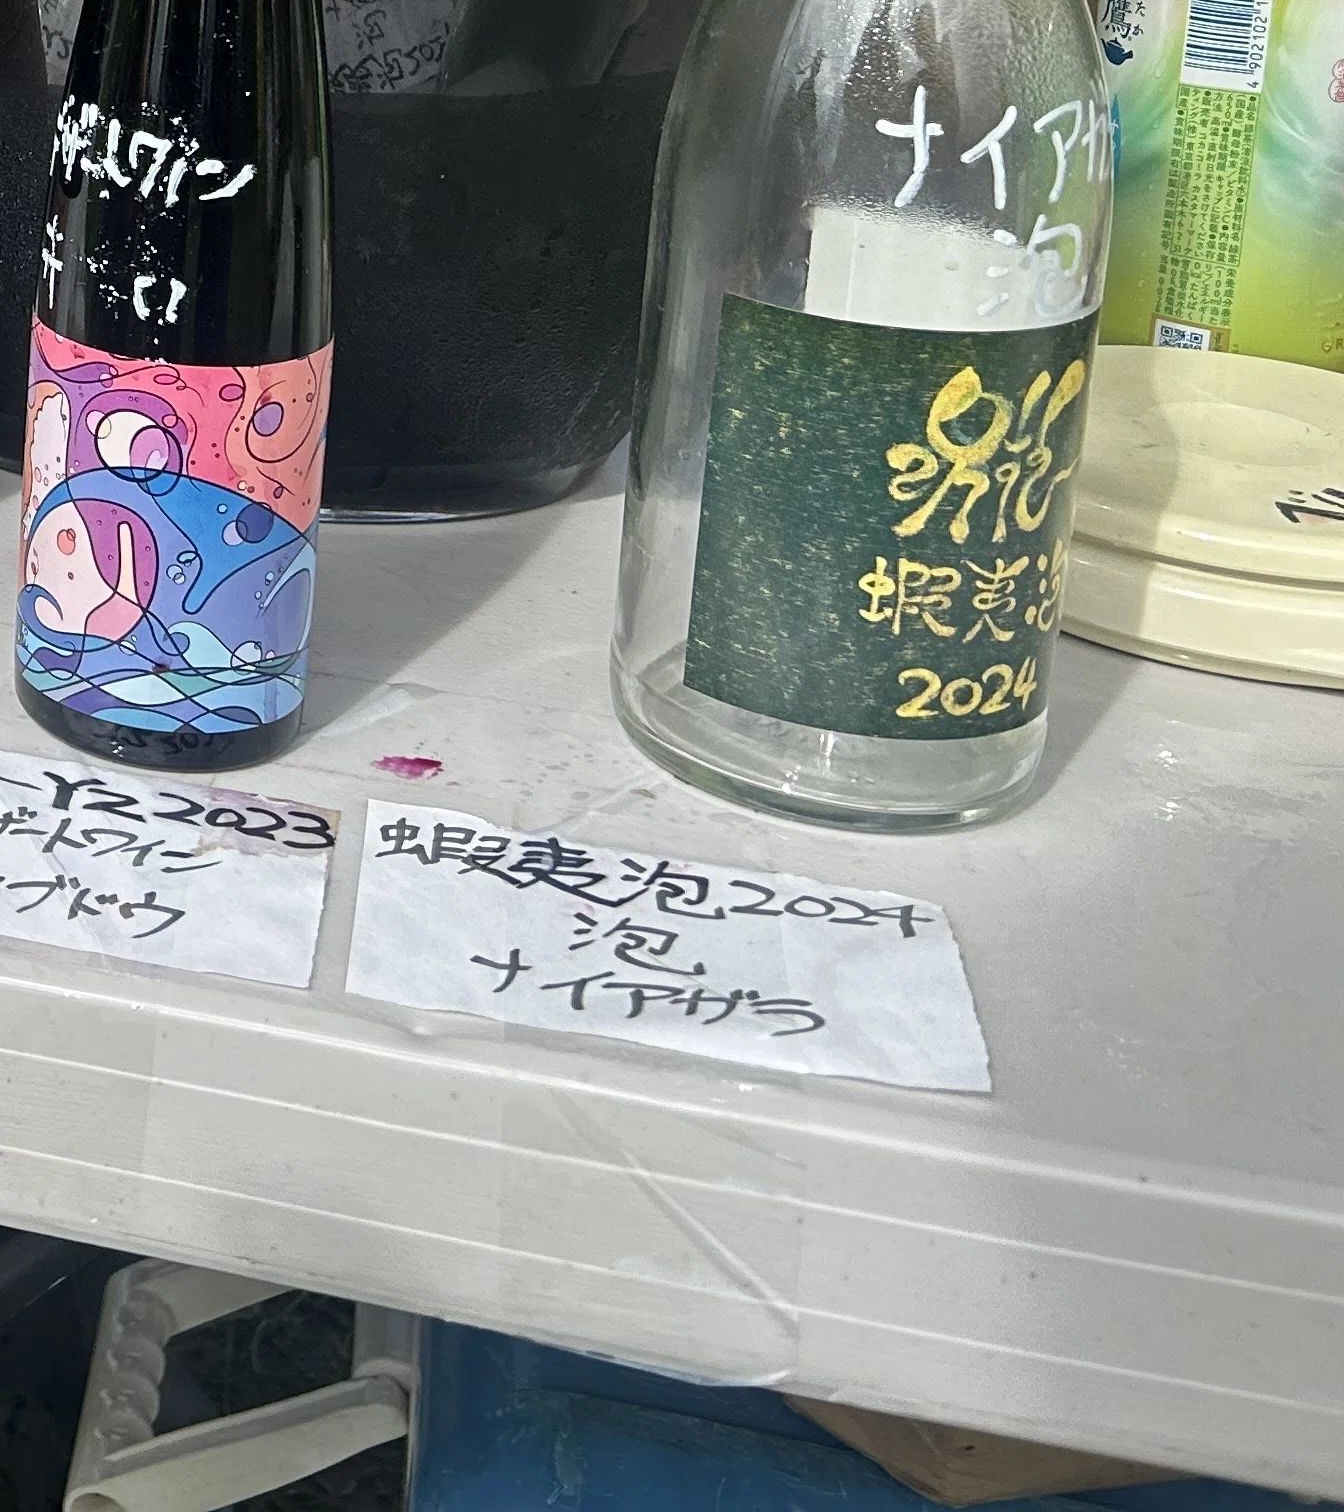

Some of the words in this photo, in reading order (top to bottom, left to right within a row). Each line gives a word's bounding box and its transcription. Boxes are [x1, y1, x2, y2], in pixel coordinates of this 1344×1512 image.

[1248, 16, 1269, 70] 902102
[1247, 80, 1260, 89] 4
[976, 213, 1089, 319] 泡
[895, 657, 1038, 719] 2024
[567, 911, 707, 976] 泡
[469, 947, 826, 1038] ナイアガラ
